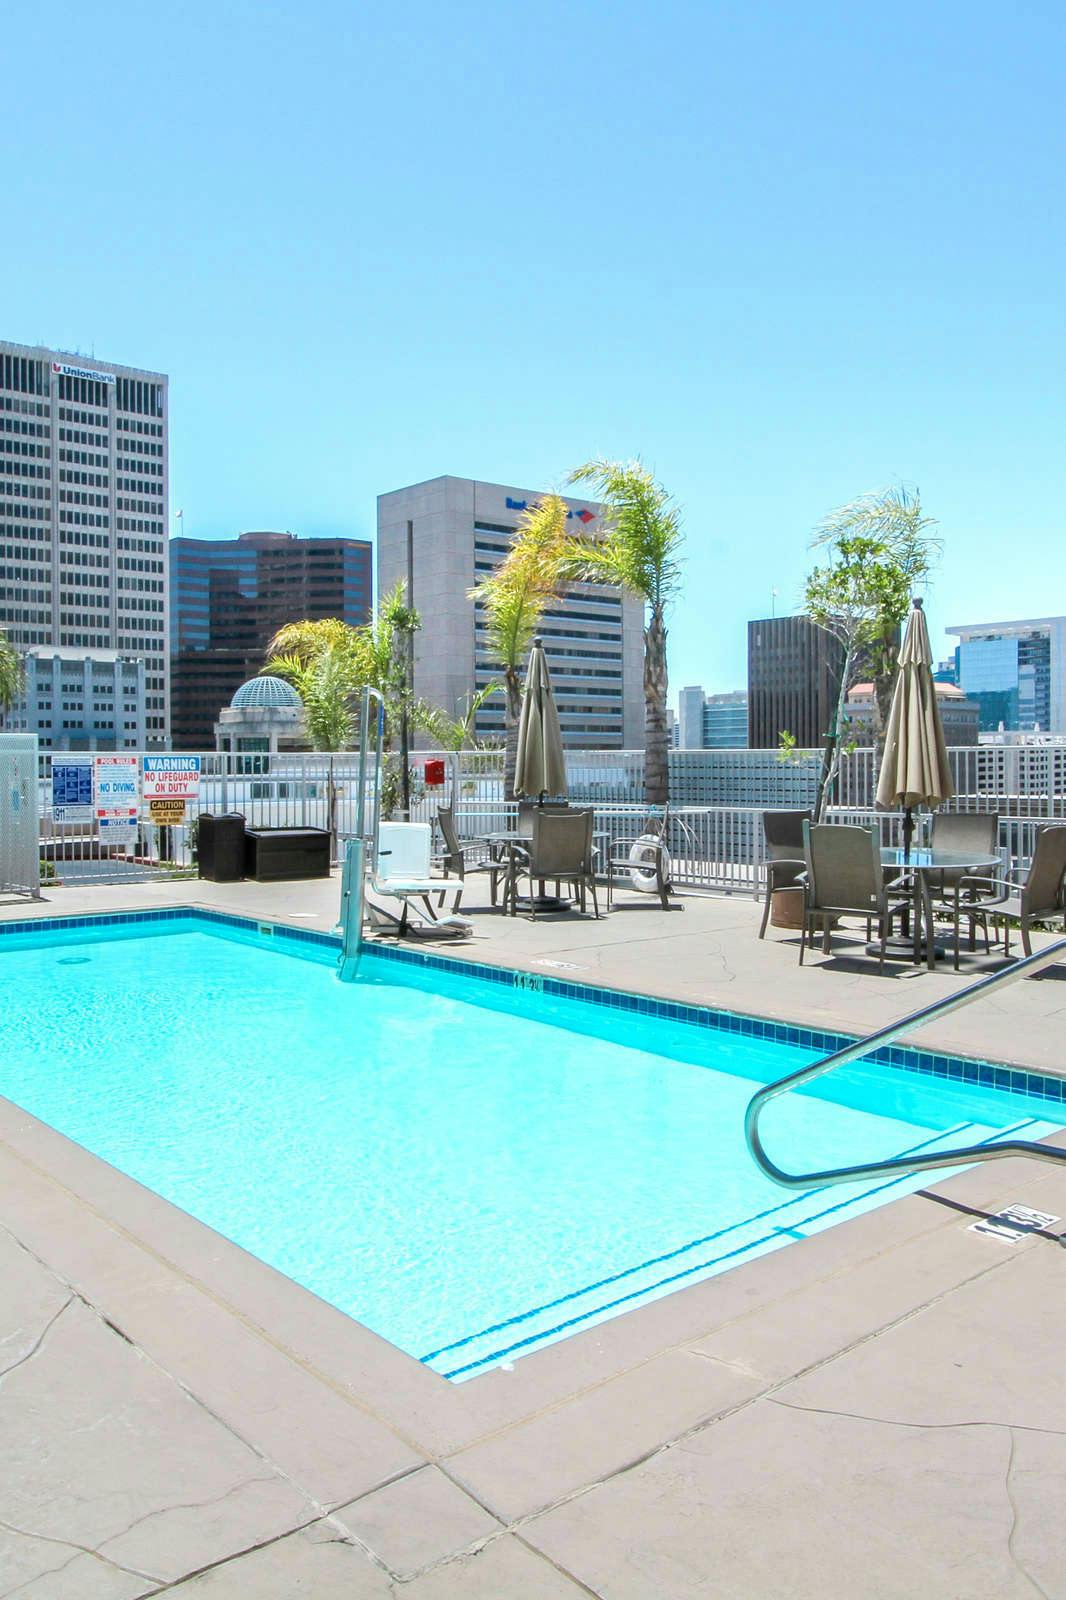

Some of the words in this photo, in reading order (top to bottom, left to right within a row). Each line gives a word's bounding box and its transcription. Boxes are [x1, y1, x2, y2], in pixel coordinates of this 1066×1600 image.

[63, 366, 115, 383] UnionBank
[147, 758, 196, 770] WARNING
[144, 772, 155, 781] NO
[158, 772, 199, 781] LIFEGUARD
[100, 783, 110, 792] NO
[112, 783, 135, 792] DIVING
[155, 783, 165, 792] ON
[168, 783, 188, 792] DUTY
[151, 801, 184, 809] CAUTION
